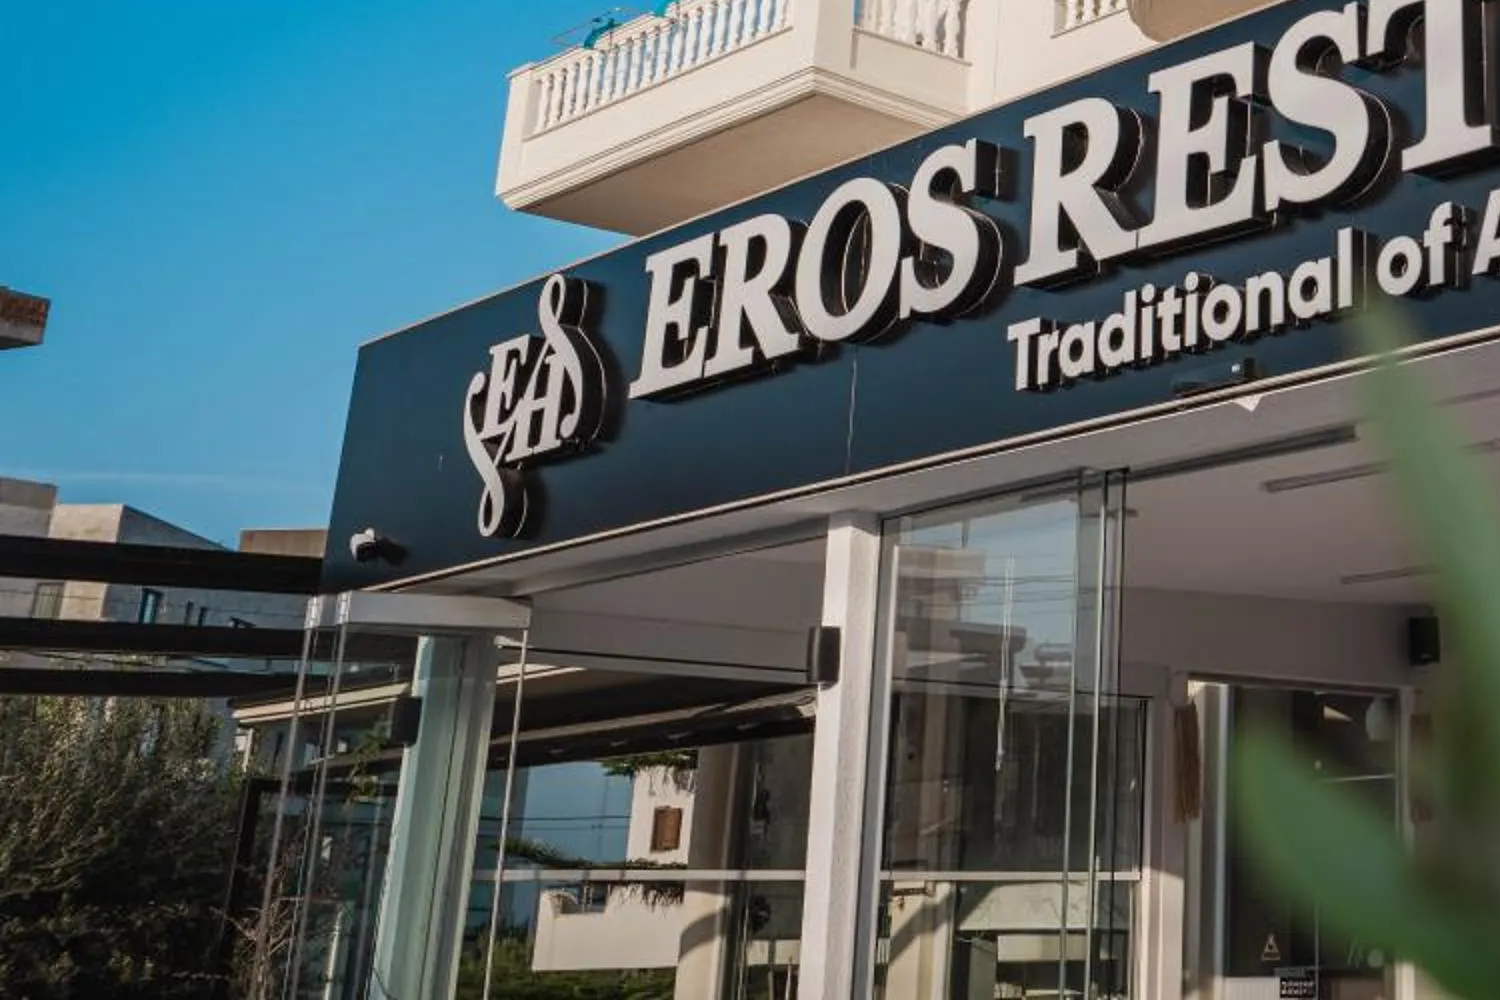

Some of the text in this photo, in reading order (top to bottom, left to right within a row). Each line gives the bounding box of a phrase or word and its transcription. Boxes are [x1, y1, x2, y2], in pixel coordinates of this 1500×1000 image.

[631, 139, 980, 398] EROS
[1008, 227, 1354, 390] Traditional
[1376, 203, 1456, 297] of
